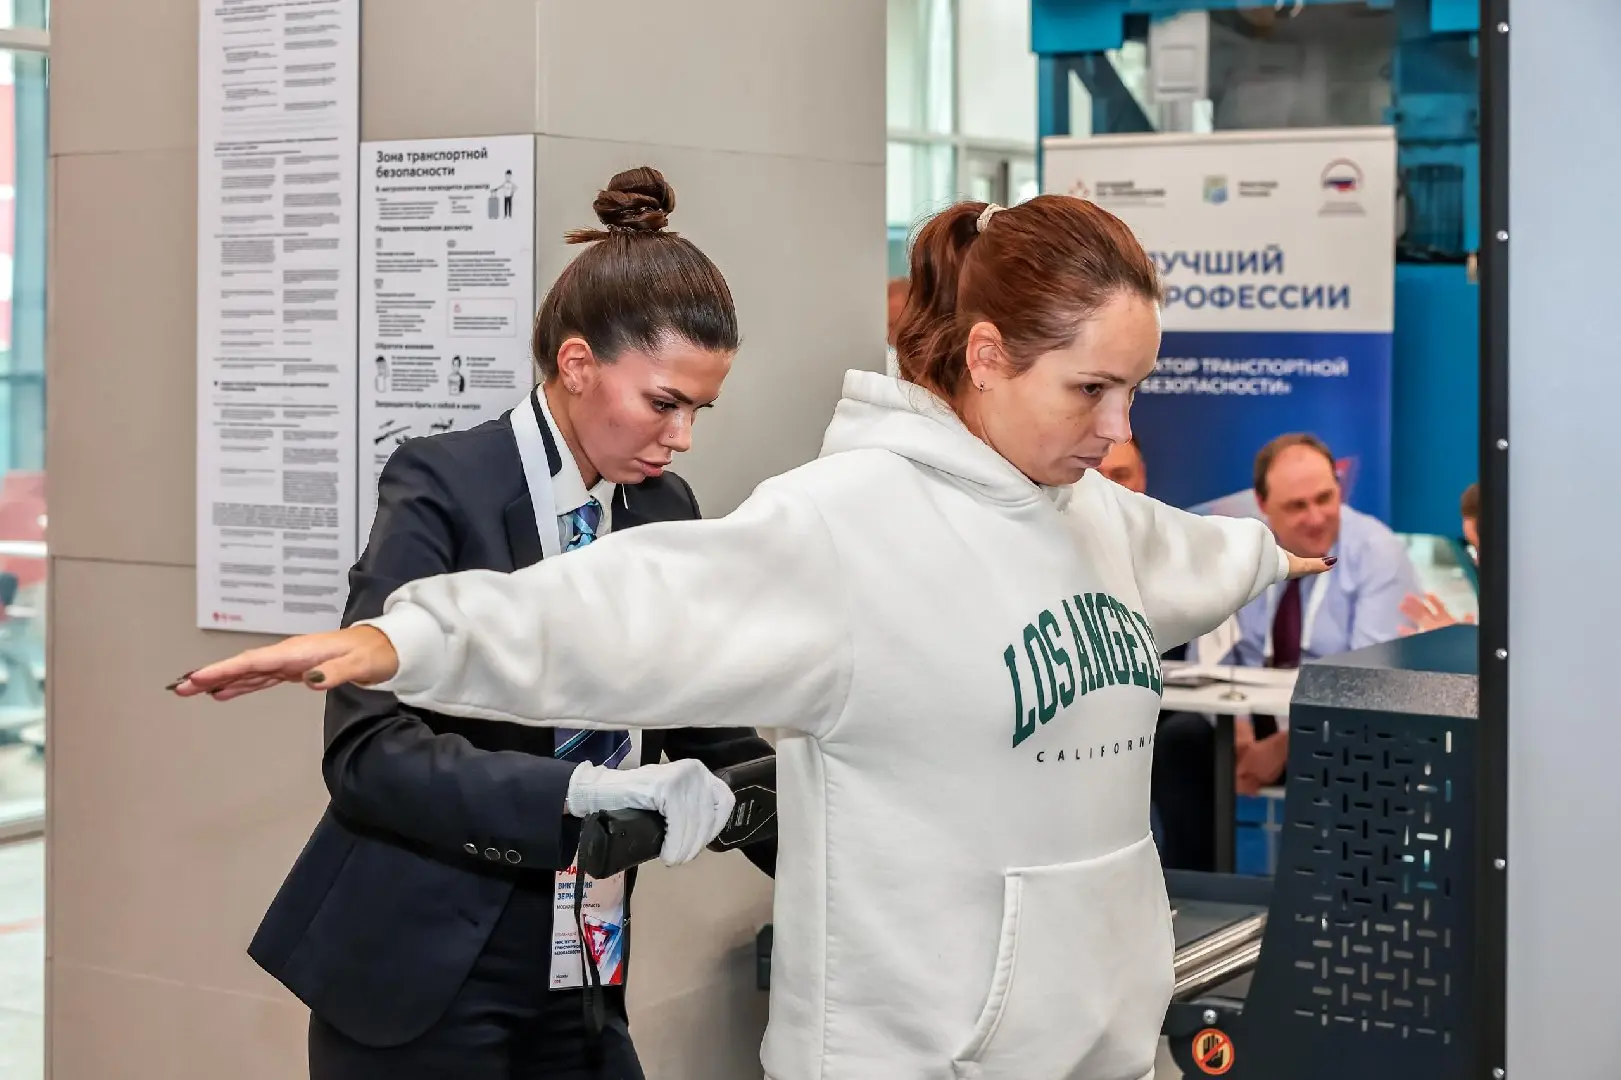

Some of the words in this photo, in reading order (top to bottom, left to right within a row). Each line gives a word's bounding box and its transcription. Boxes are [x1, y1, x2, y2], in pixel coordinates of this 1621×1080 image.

[376, 150, 404, 163] Зона
[407, 147, 488, 163] транспортной
[376, 165, 455, 178] безопасности
[1164, 284, 1350, 309] РОФЕССИИ
[1156, 357, 1199, 375] КТОР
[1201, 356, 1349, 377] ТРАНСПОРТНОЙ
[1003, 609, 1076, 748] LOS
[1061, 592, 1163, 699] ANGEL
[1036, 734, 1152, 763] CALIFORNI
